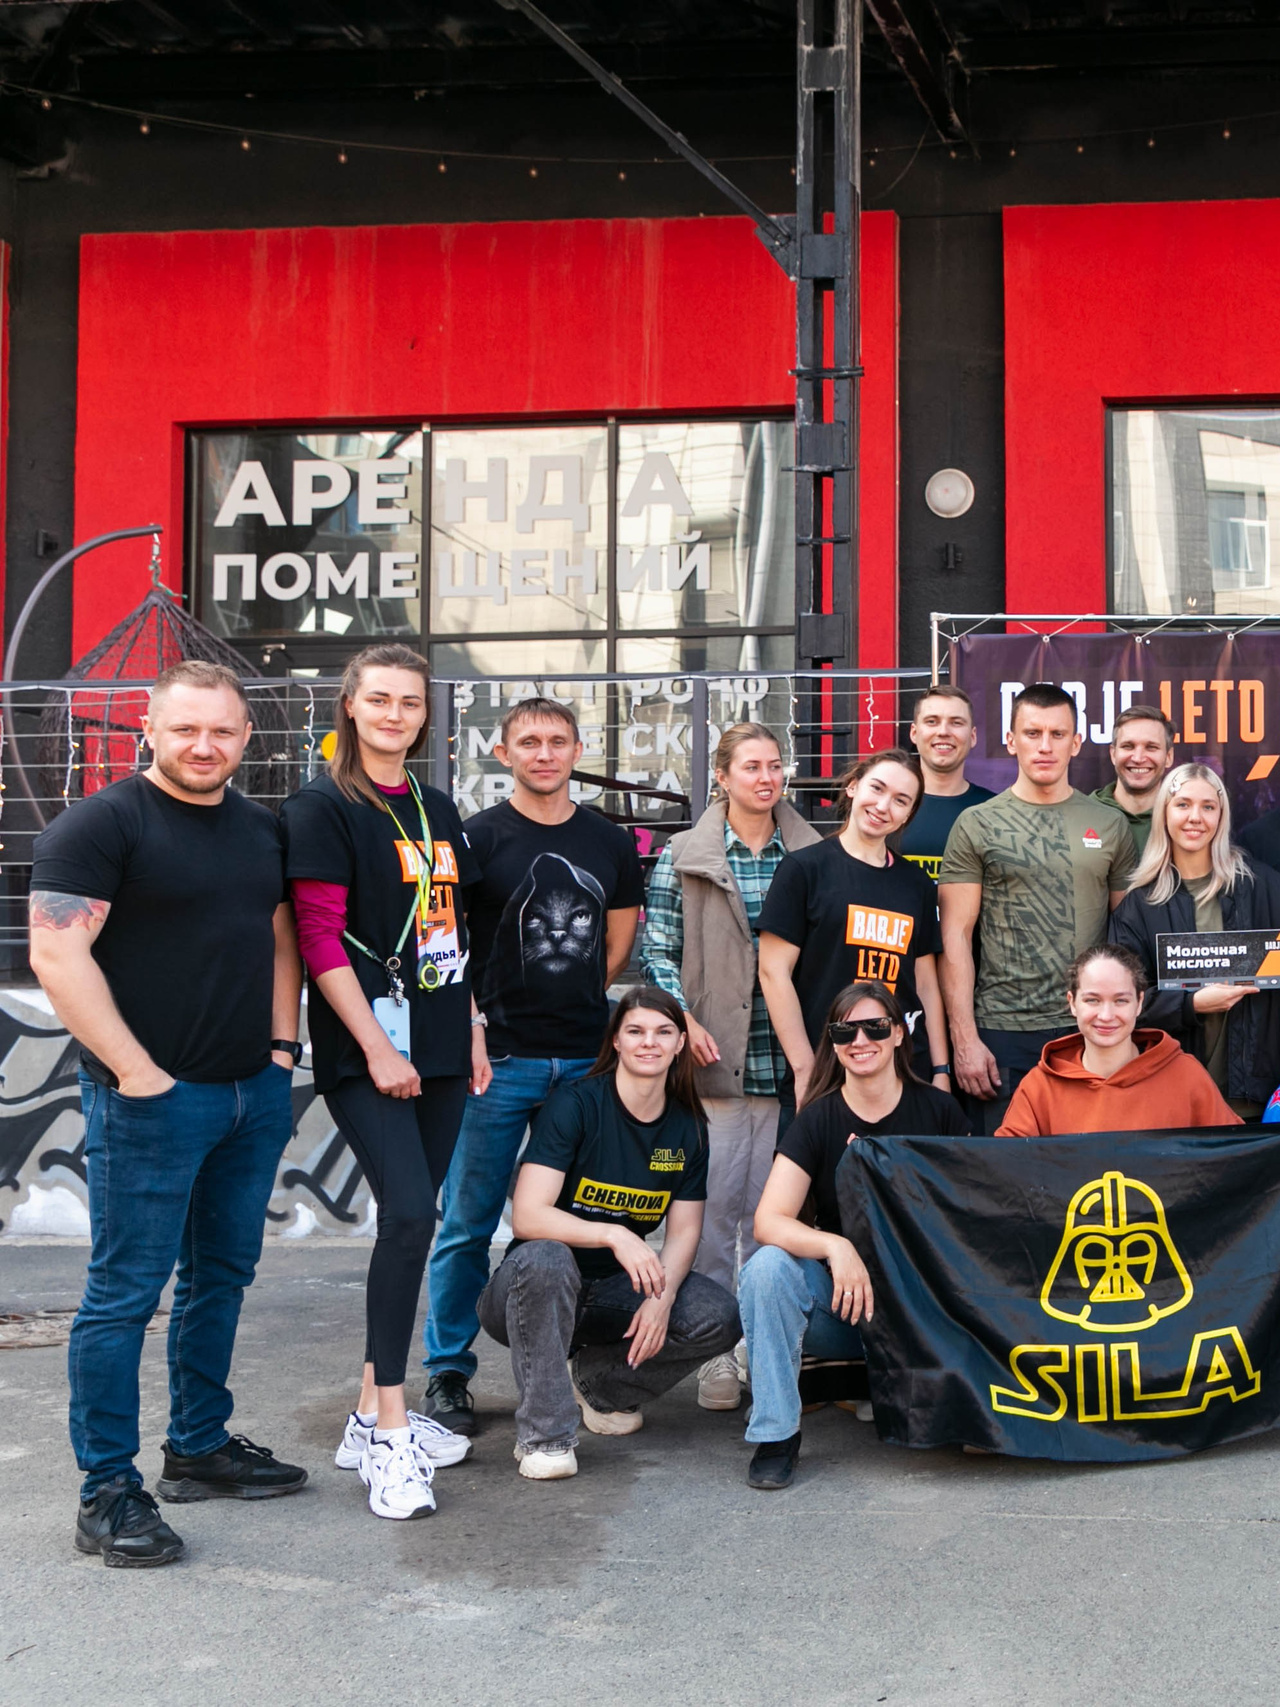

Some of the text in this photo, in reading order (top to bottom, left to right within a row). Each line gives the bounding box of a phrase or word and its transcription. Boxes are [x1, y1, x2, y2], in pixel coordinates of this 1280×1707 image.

[213, 451, 694, 533] АРЕНДА
[213, 530, 712, 605] ПОМЕЩЕНИЙ
[852, 910, 910, 948] BABJE
[429, 950, 456, 962] УДЬЯ
[1167, 944, 1248, 958] Молочная
[1167, 956, 1231, 970] кислота
[651, 1148, 686, 1161] SILA
[581, 1184, 665, 1210] CHERNOVA
[991, 1326, 1261, 1422] SILA
